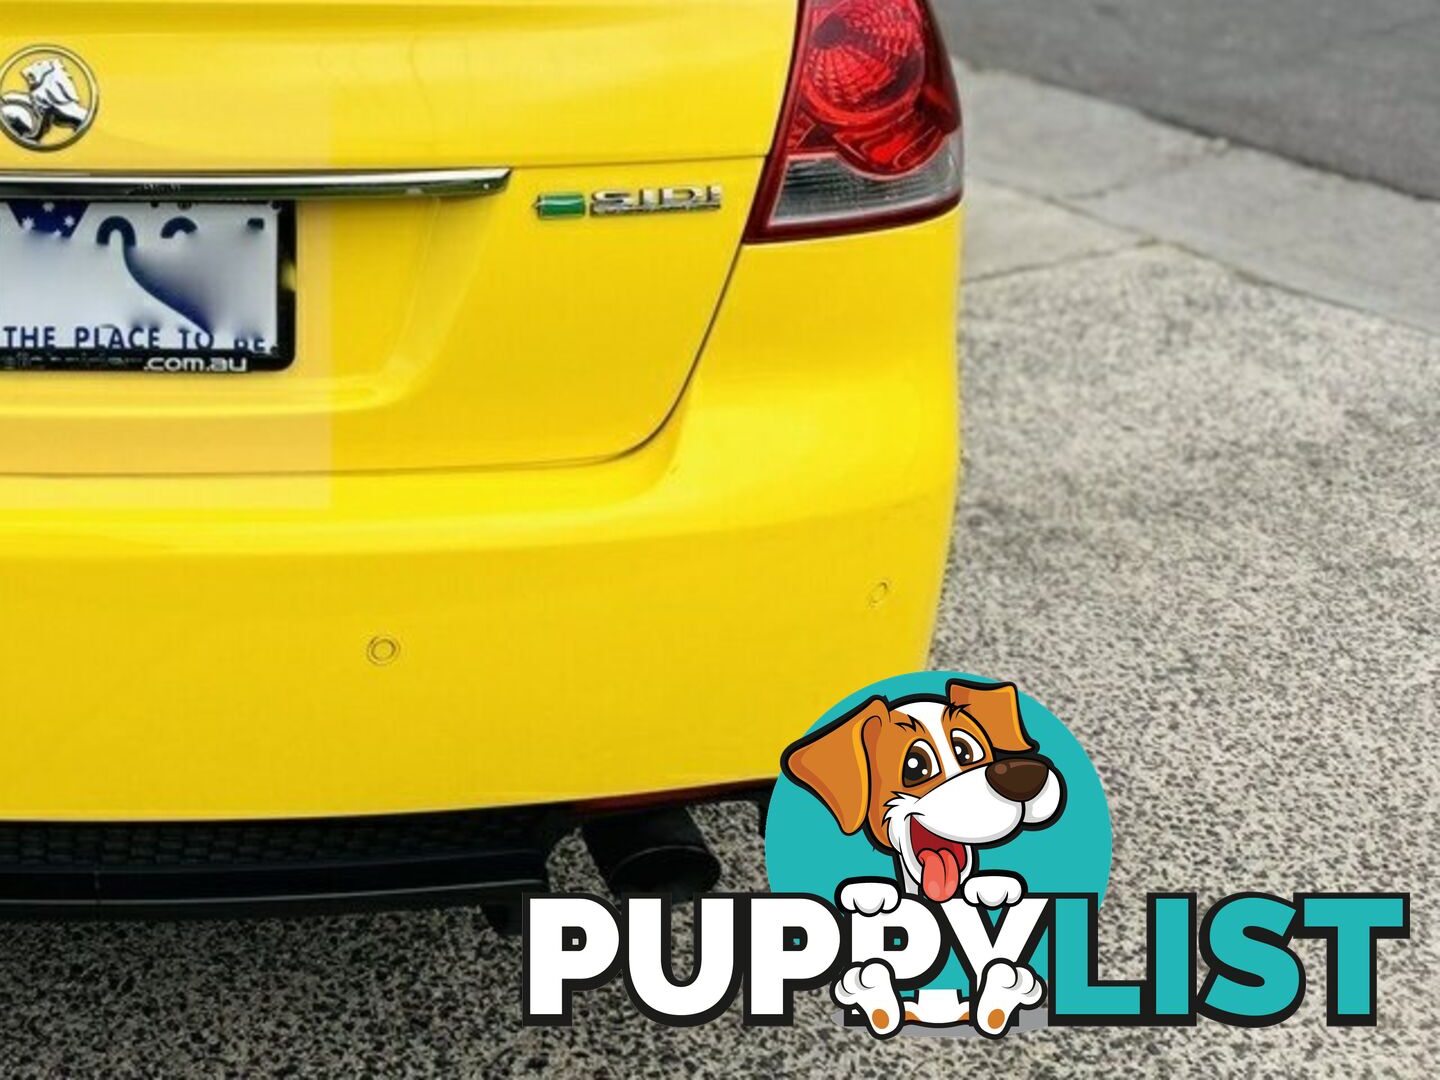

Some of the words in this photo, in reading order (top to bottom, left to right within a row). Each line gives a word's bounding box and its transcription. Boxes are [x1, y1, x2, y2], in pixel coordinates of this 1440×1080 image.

[590, 185, 720, 215] SIDI
[3, 326, 57, 349] THE
[75, 326, 160, 350] PLACE
[178, 328, 215, 350] TO
[143, 356, 247, 372] .com.au
